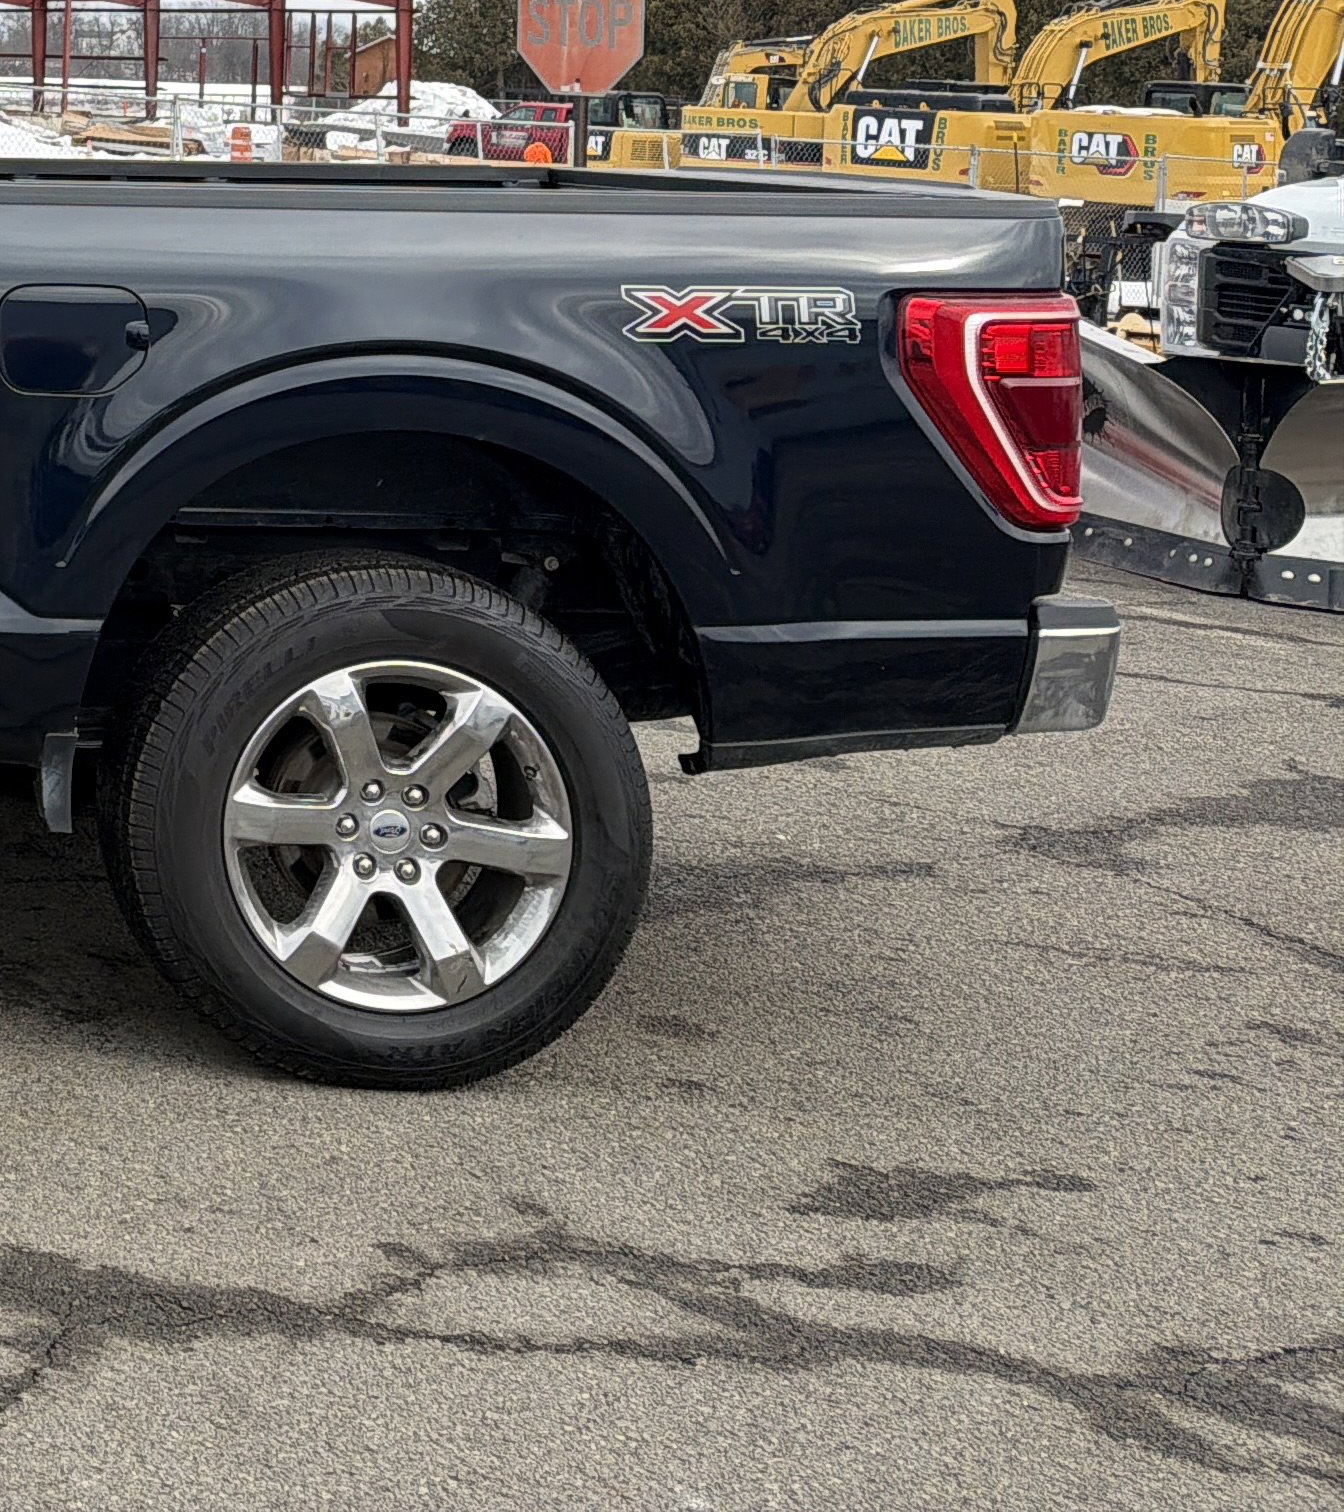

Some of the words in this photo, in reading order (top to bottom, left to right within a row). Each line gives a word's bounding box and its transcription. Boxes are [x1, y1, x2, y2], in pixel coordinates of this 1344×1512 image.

[894, 18, 932, 49] BAKER
[1102, 18, 1140, 51] BAKER
[1142, 13, 1173, 39] BROS.
[716, 117, 759, 129] BROS
[855, 115, 924, 162] CAT
[587, 135, 606, 156] AT
[698, 136, 730, 160] CAT
[1072, 132, 1123, 166] CAT
[1233, 143, 1259, 168] CAT
[621, 285, 861, 342] XTR
